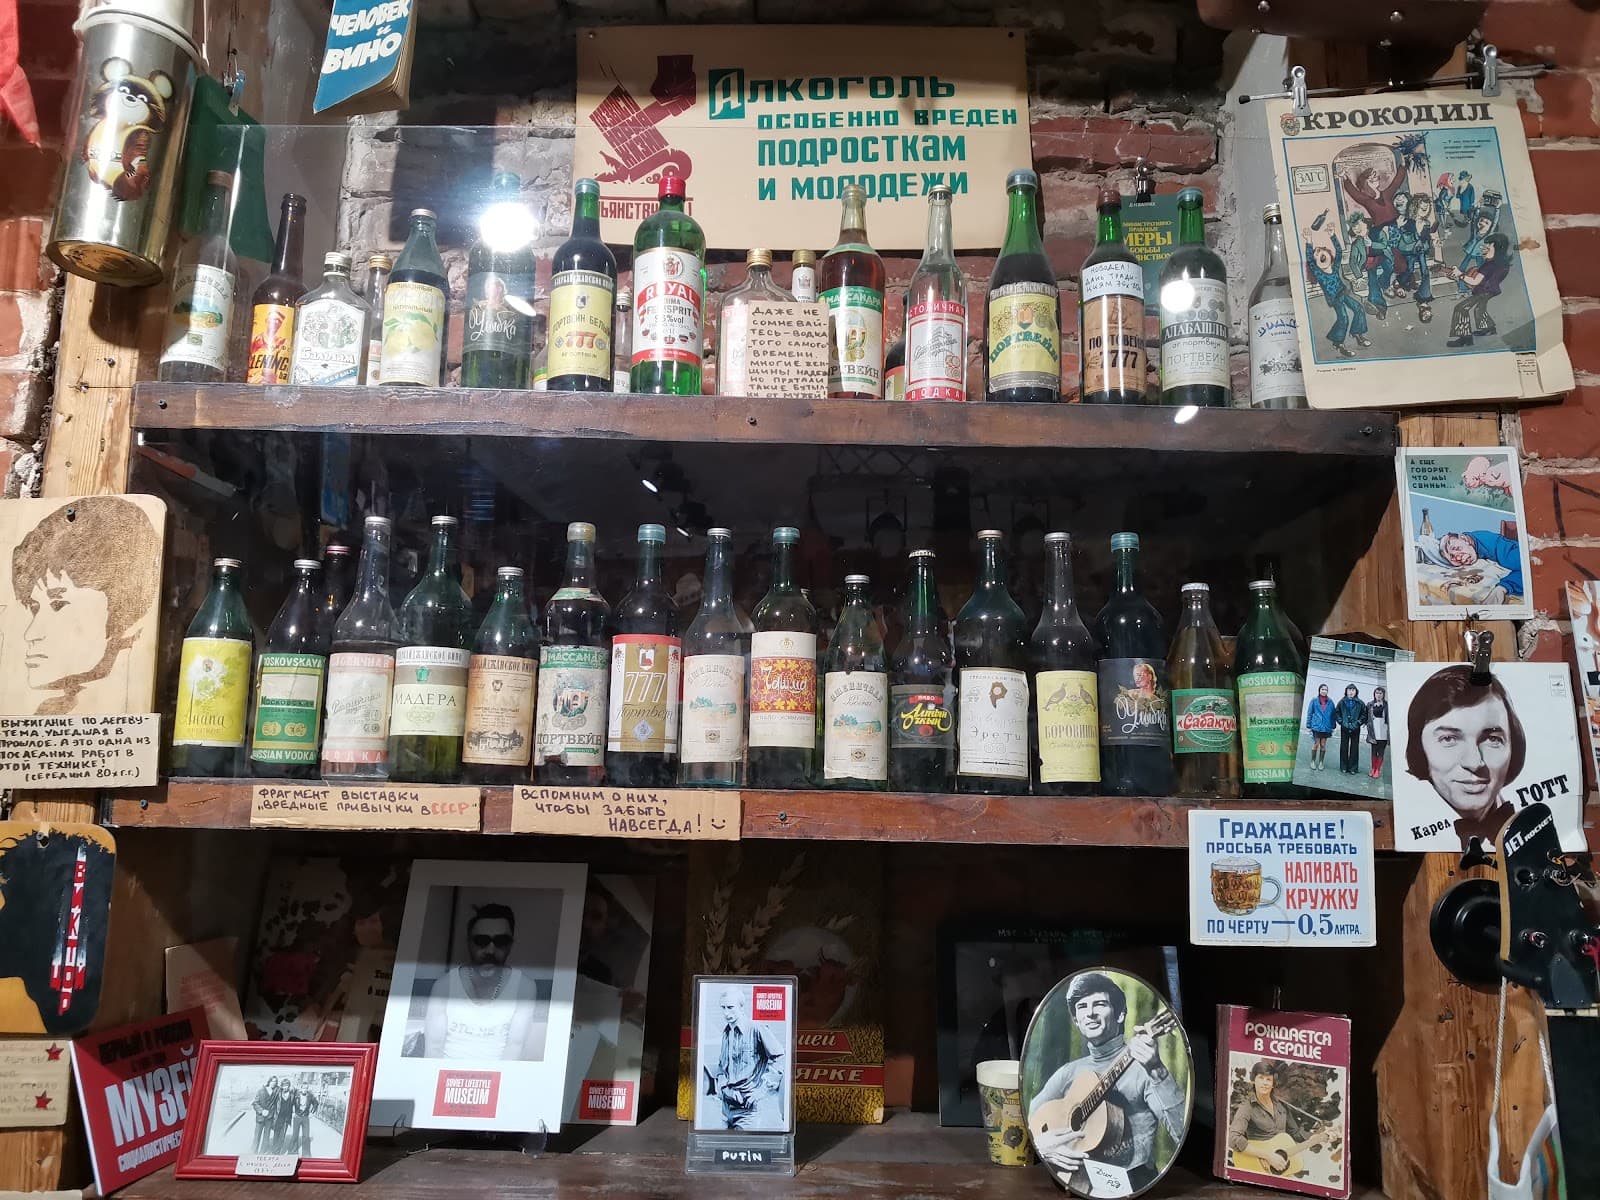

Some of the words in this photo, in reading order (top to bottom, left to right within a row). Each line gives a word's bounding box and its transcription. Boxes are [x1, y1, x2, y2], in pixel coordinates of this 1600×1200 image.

[331, 0, 410, 36] ЧЕЛОВЕК
[321, 32, 402, 74] ВИНО
[758, 110, 898, 130] ОСОБЕННО
[915, 108, 1017, 127] ВРЕДЕН
[1302, 103, 1493, 131] КРОКОДИЛ
[758, 134, 966, 167] ПОДРОСТКАМ
[1296, 168, 1325, 186] ЗАГС
[758, 177, 776, 200] И
[646, 284, 696, 303] RYAL
[752, 307, 794, 316] ДАЖЕ
[750, 329, 782, 337] ТЕСЬ
[793, 330, 828, 338] ВОДКА
[1164, 321, 1228, 338] АЛАБАШЛЫ
[753, 350, 818, 358] ВРЕМЕНИ.
[748, 368, 790, 376] ЩИНЫ
[911, 390, 961, 399] ВОДКА
[263, 656, 324, 668] OSKOVSKAYA
[625, 671, 667, 703] 777
[394, 693, 457, 707] МАДЕРА
[1, 718, 75, 728] ВЫЖИГАНИЕ
[82, 717, 97, 725] ПО
[45, 728, 109, 737] УШЕДШАЯ
[115, 727, 124, 735] В
[61, 738, 69, 746] А
[72, 739, 93, 747] ЭТО
[98, 737, 133, 746] ОДНА
[136, 736, 152, 745] ИЗ
[82, 749, 120, 758] РАБОТ
[126, 749, 134, 757] В
[285, 750, 316, 761] VODKA
[38, 759, 106, 770] ТЕХНИКЕ!
[25, 770, 91, 782] (СЕРЕДИНА
[258, 788, 330, 800] ФРАГМЕНТ
[341, 790, 419, 802] ВЫСТАВКИ
[521, 788, 604, 800] ВСПОМНИМ
[612, 792, 621, 802] О
[626, 793, 668, 806] НИХ,
[336, 802, 413, 813] ПРИВЫЧКИ
[535, 803, 590, 814] ЧТОБЫ
[602, 804, 666, 816] ЗАБЫТЬ
[1410, 817, 1453, 840] Карел
[1516, 773, 1570, 808] ГОТТ
[608, 813, 702, 834] НАВСЕГДА!
[1219, 818, 1345, 840] ГРАЖДАНЕ!
[1504, 831, 1525, 858] JET
[1524, 815, 1554, 843] ROCKET
[1206, 842, 1272, 854] ПРОСЬБА
[1277, 842, 1358, 855] ТРЕБОВАТЬ
[1285, 861, 1358, 884] НАЛИВАТЬ
[1286, 888, 1359, 910] КРУЖКУ
[1207, 919, 1225, 934] ПО
[1228, 919, 1270, 934] ЧЕРТУ
[1298, 913, 1334, 937] 0,5
[756, 999, 783, 1010] MUSEUM
[1245, 1022, 1332, 1047] РОЖДАЕТСЯ
[1254, 1037, 1263, 1052] В
[1269, 1040, 1322, 1060] СЕРДЦЕ
[446, 1079, 464, 1088] SOVIET
[464, 1079, 491, 1089] LIFESTYLE
[444, 1087, 490, 1105] MUSEUM
[587, 1094, 626, 1110] MUSEUM
